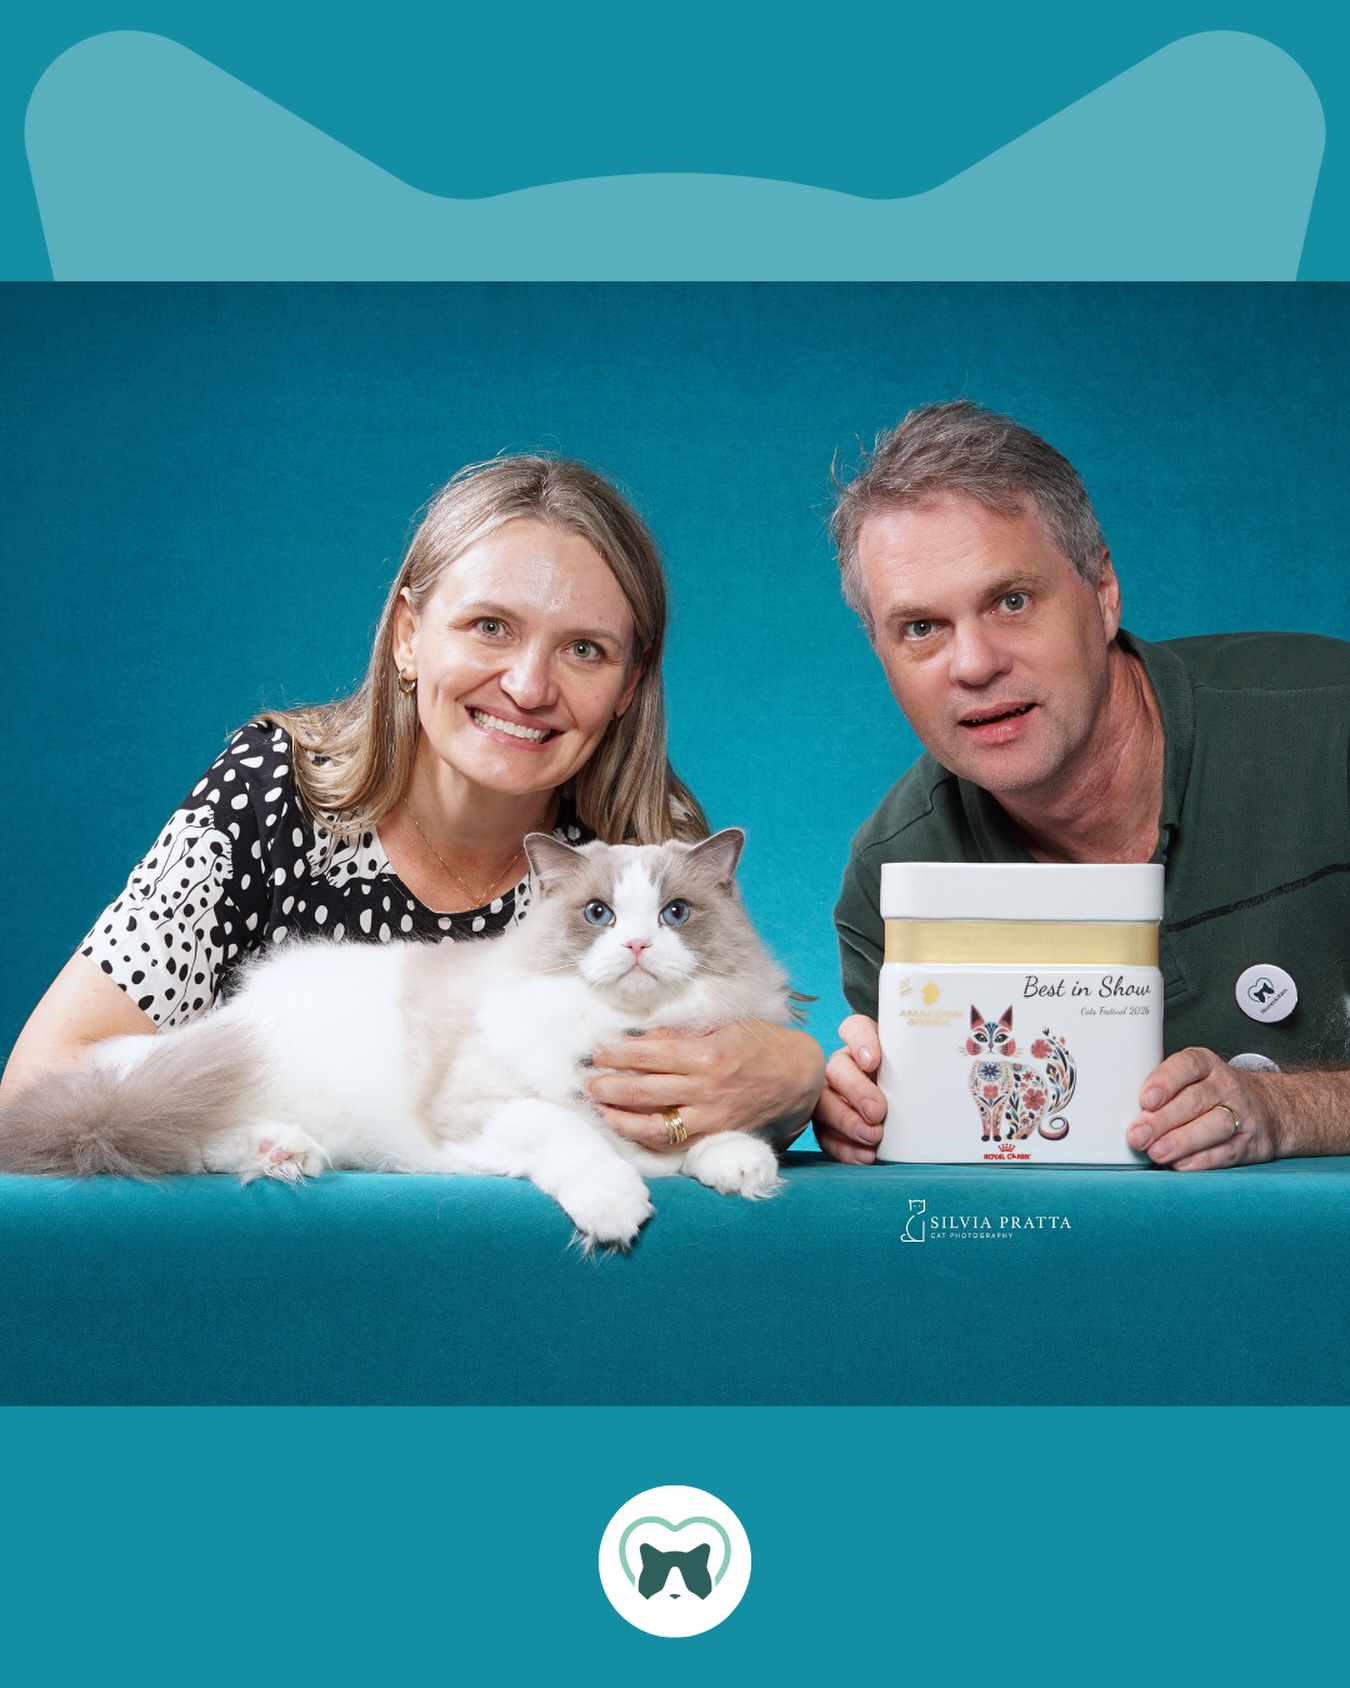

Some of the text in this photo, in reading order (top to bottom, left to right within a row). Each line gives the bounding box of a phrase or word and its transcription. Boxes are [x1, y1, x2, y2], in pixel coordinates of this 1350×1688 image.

[1023, 975, 1151, 998] Best in Show
[899, 1009, 963, 1019] AMACOON
[1080, 1005, 1150, 1016] Cats Festival 2026
[907, 1018, 952, 1027] BRASIL
